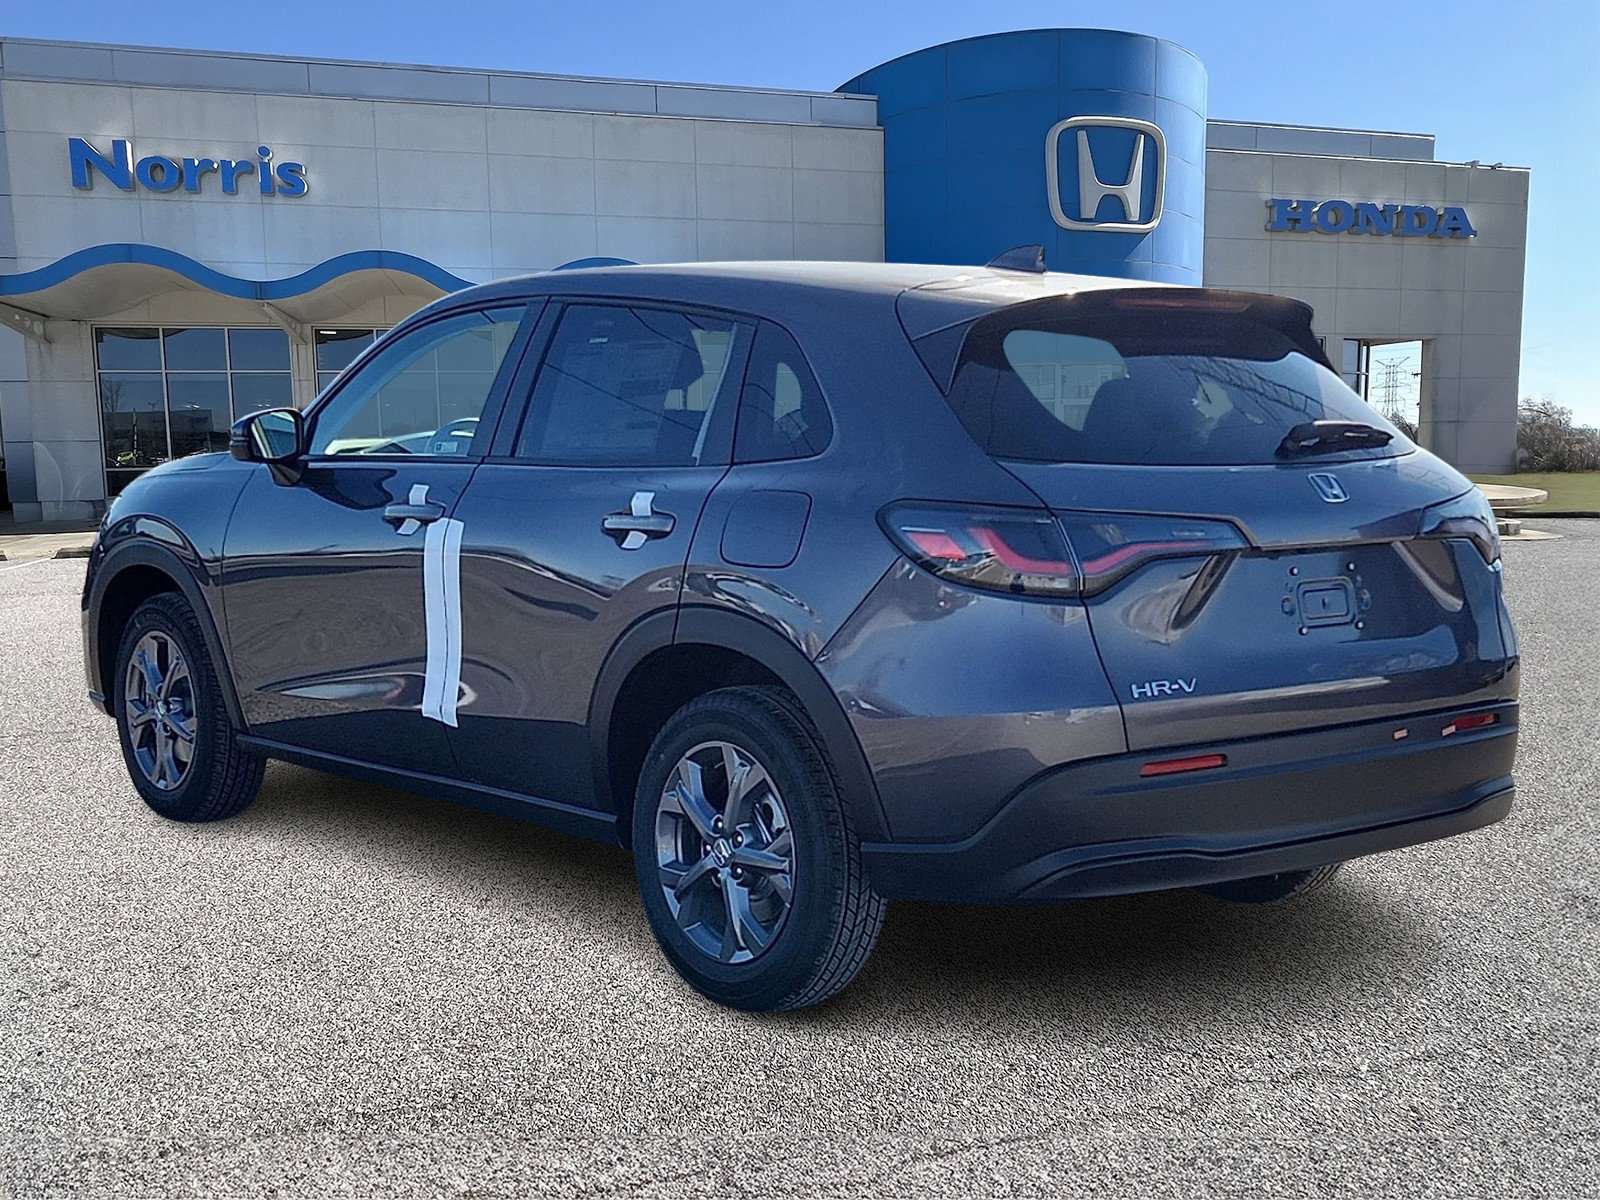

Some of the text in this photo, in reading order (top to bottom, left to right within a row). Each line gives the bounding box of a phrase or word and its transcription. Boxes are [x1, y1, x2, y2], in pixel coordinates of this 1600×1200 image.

[68, 137, 309, 197] Norris
[1265, 198, 1477, 239] HONDA
[1131, 678, 1197, 699] HR-V
